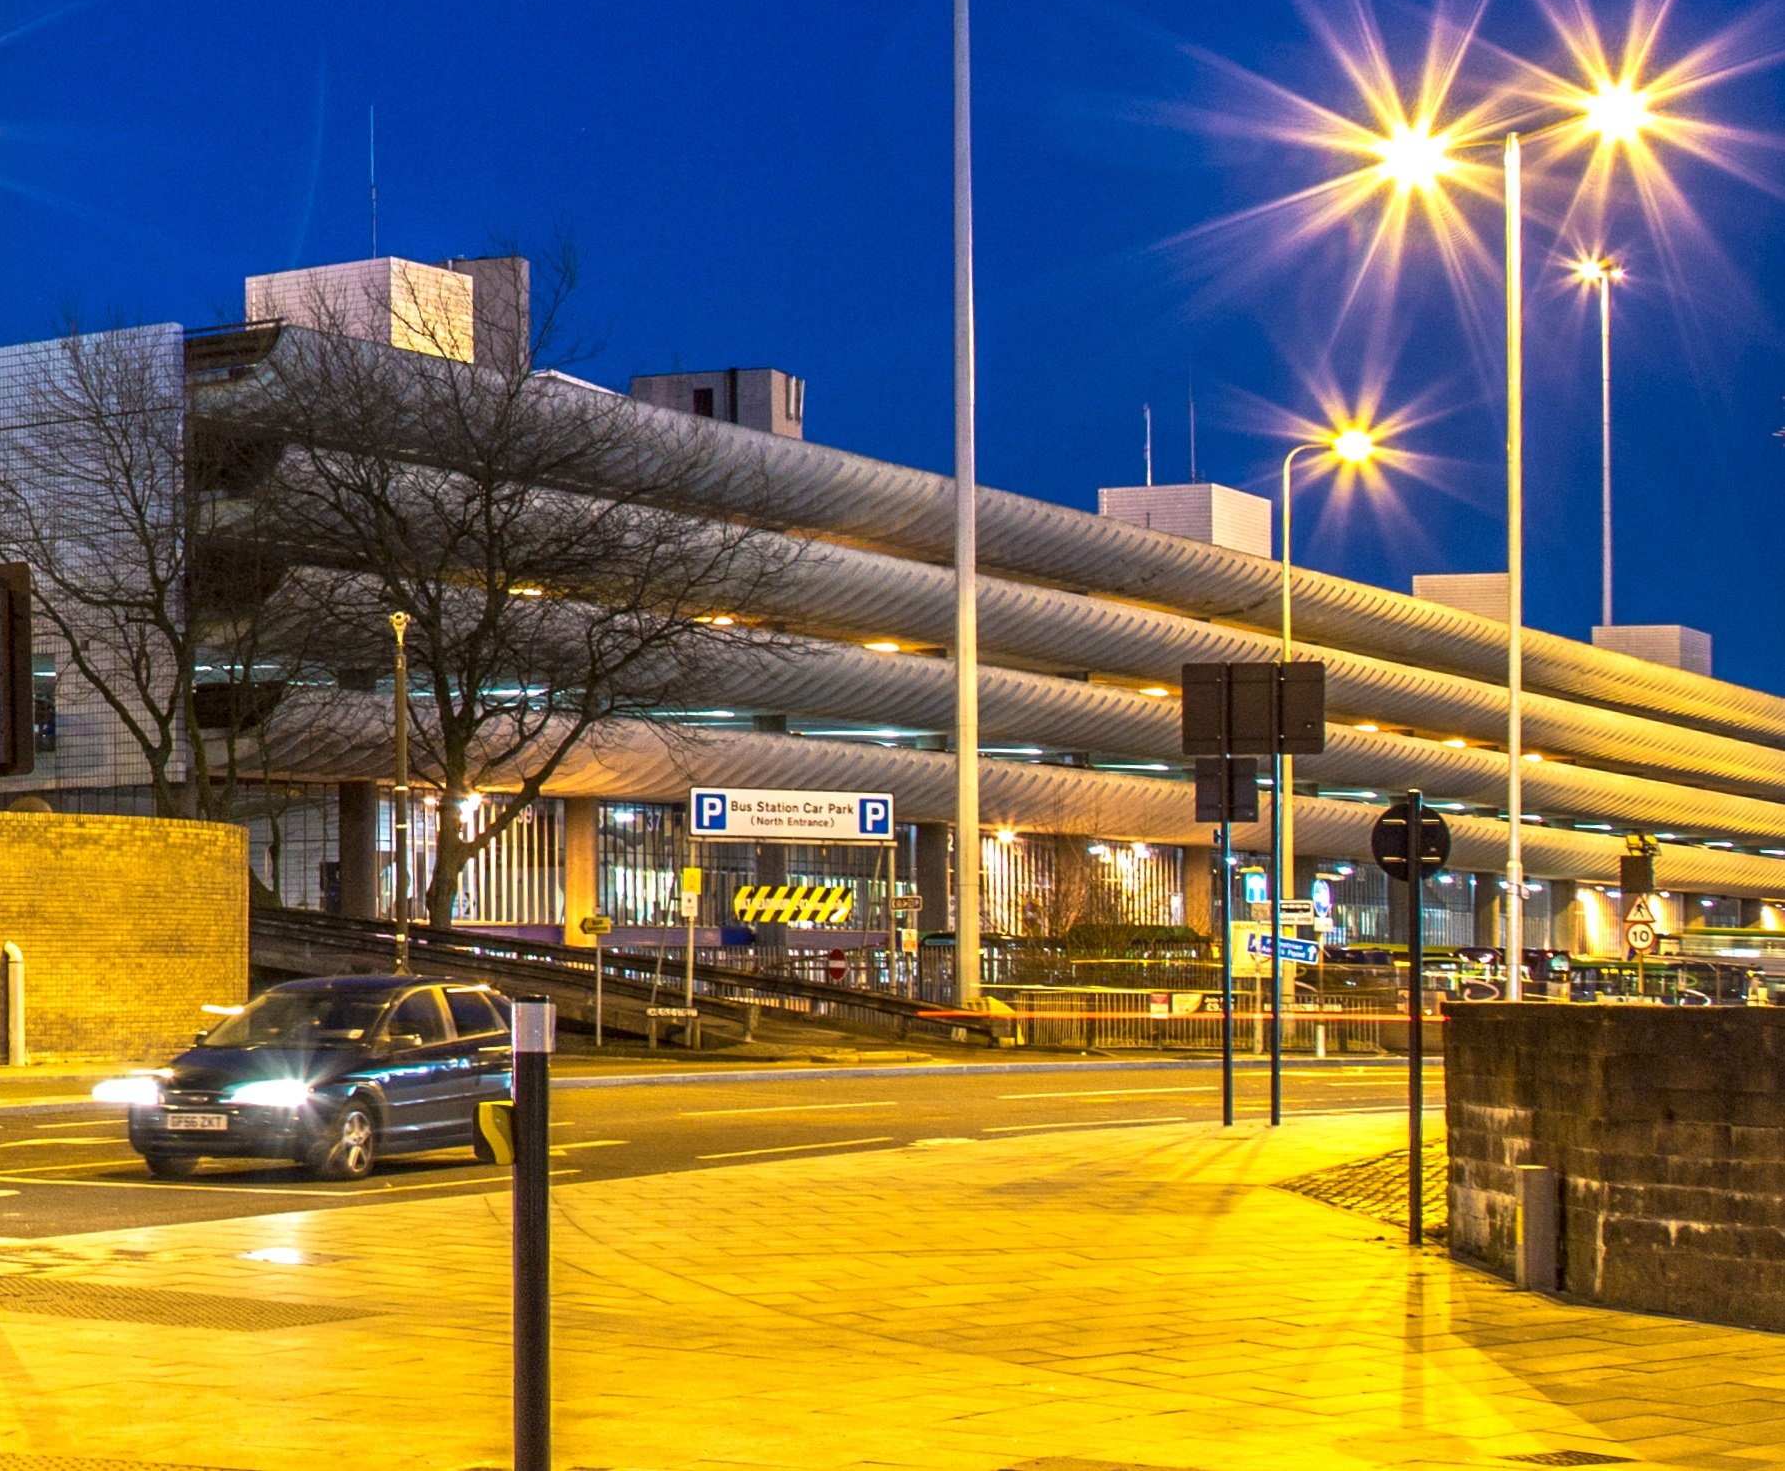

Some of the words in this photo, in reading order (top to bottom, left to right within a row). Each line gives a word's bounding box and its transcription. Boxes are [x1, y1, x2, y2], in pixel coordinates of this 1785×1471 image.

[730, 800, 752, 813] Bus
[757, 801, 799, 814] Station
[803, 802, 823, 814] Car
[828, 803, 854, 815] Park
[750, 816, 783, 827] (North
[787, 816, 835, 828] Entrance)
[1632, 930, 1650, 943] 10
